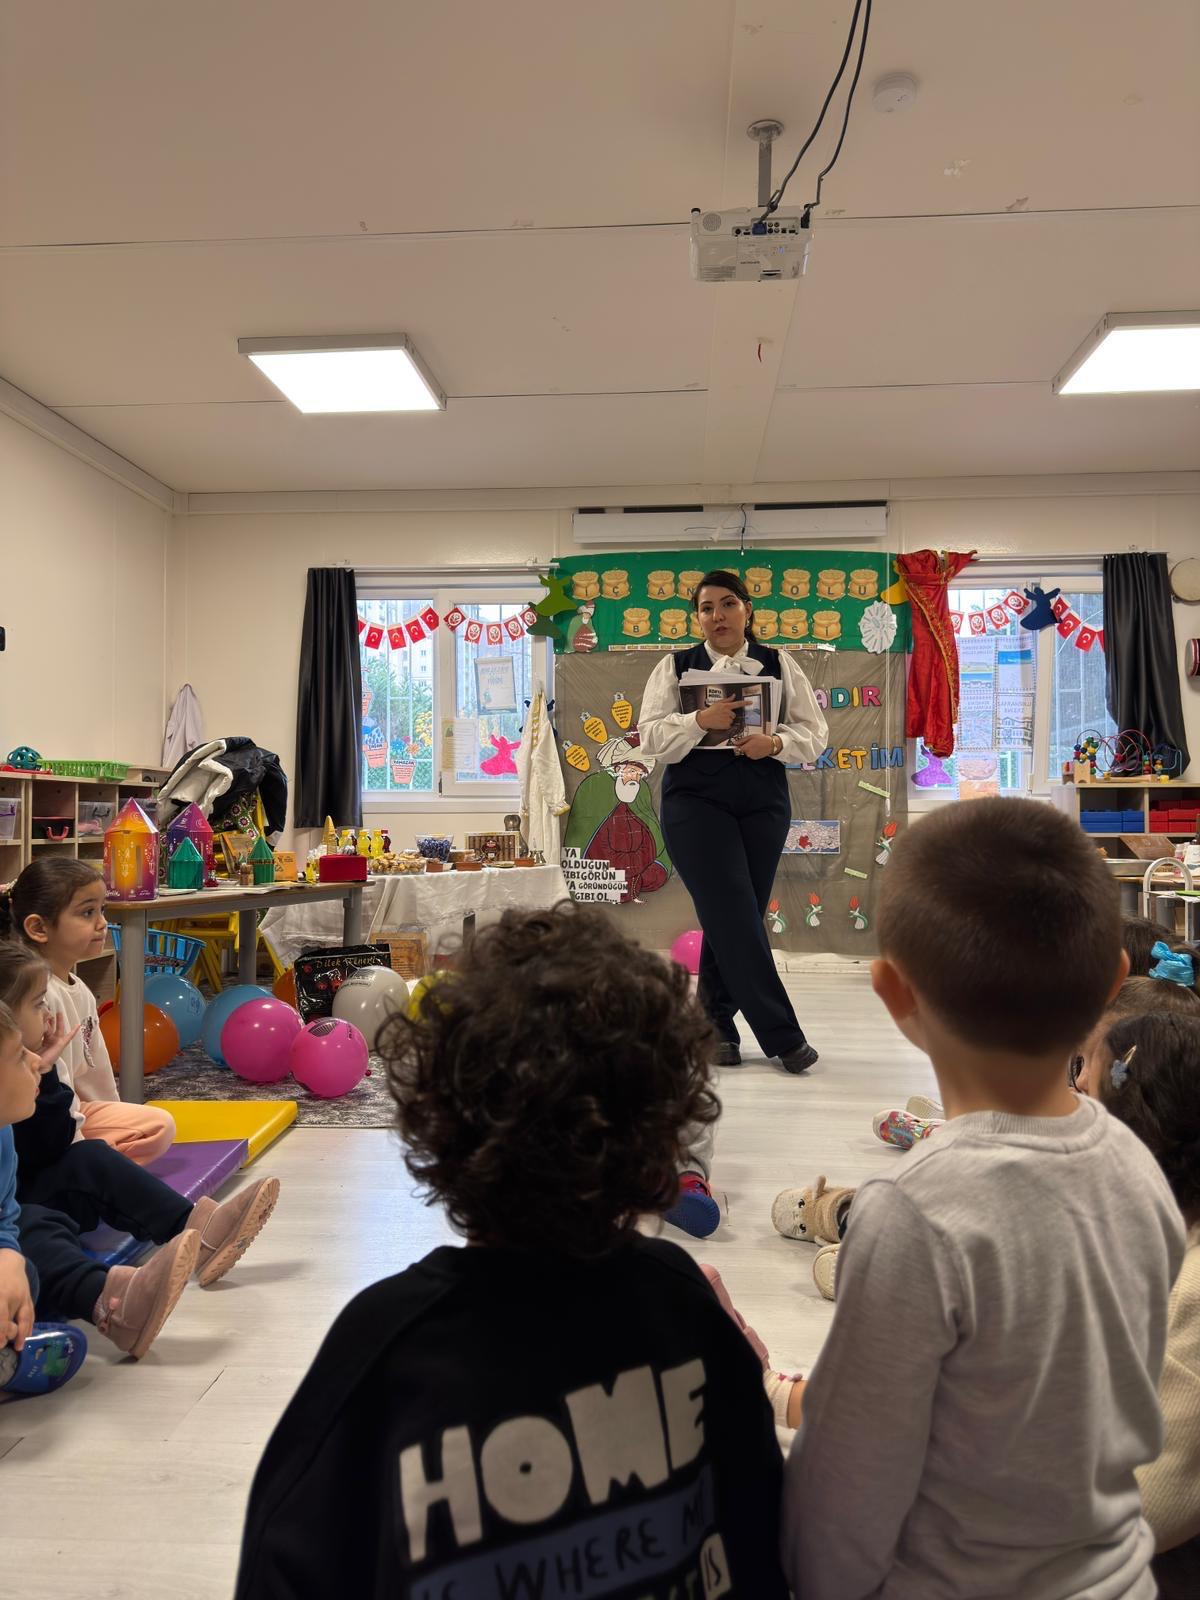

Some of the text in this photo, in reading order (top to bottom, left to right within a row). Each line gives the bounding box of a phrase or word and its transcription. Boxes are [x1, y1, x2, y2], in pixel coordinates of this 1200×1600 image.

[657, 583, 867, 597] ANDOLU
[633, 624, 829, 637] BÖESİ
[785, 743, 904, 771] KETİM
[565, 848, 577, 858] YA
[400, 1358, 706, 1563] HOME
[495, 1517, 667, 1600] WHERE
